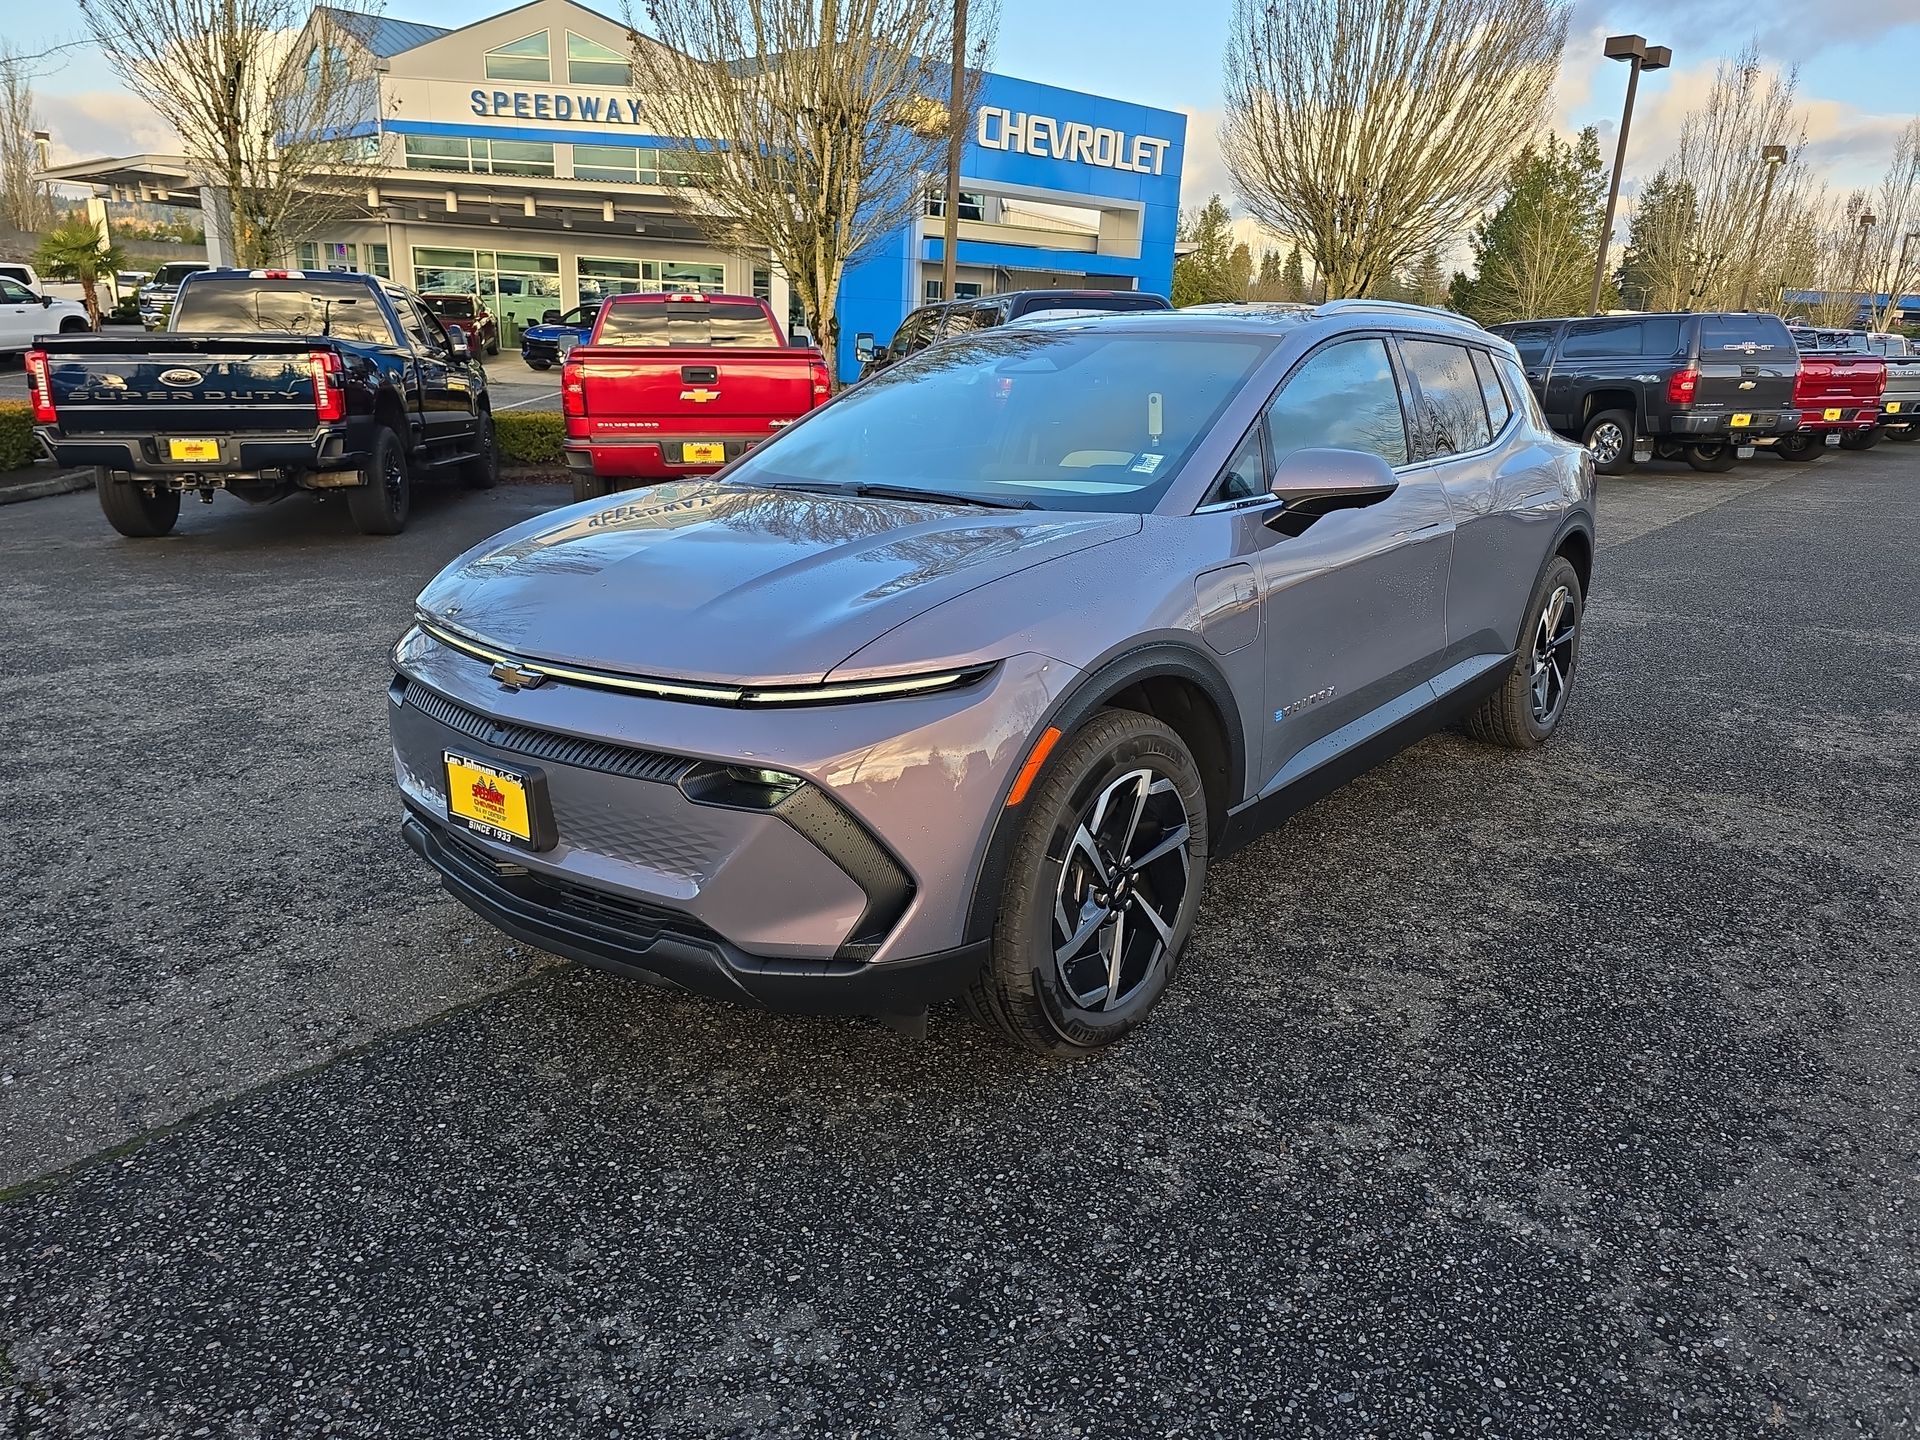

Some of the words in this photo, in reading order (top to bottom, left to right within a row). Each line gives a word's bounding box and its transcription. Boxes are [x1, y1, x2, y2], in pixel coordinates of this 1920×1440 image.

[471, 90, 643, 125] SPEEDWAY
[978, 105, 1171, 176] CHEVROLET
[68, 391, 195, 401] SUPER
[203, 391, 300, 400] DUTY
[472, 783, 506, 807] SPEEDWAY
[473, 798, 505, 815] CHEVROLET
[468, 820, 491, 835] SINCE
[493, 829, 512, 843] 1933
